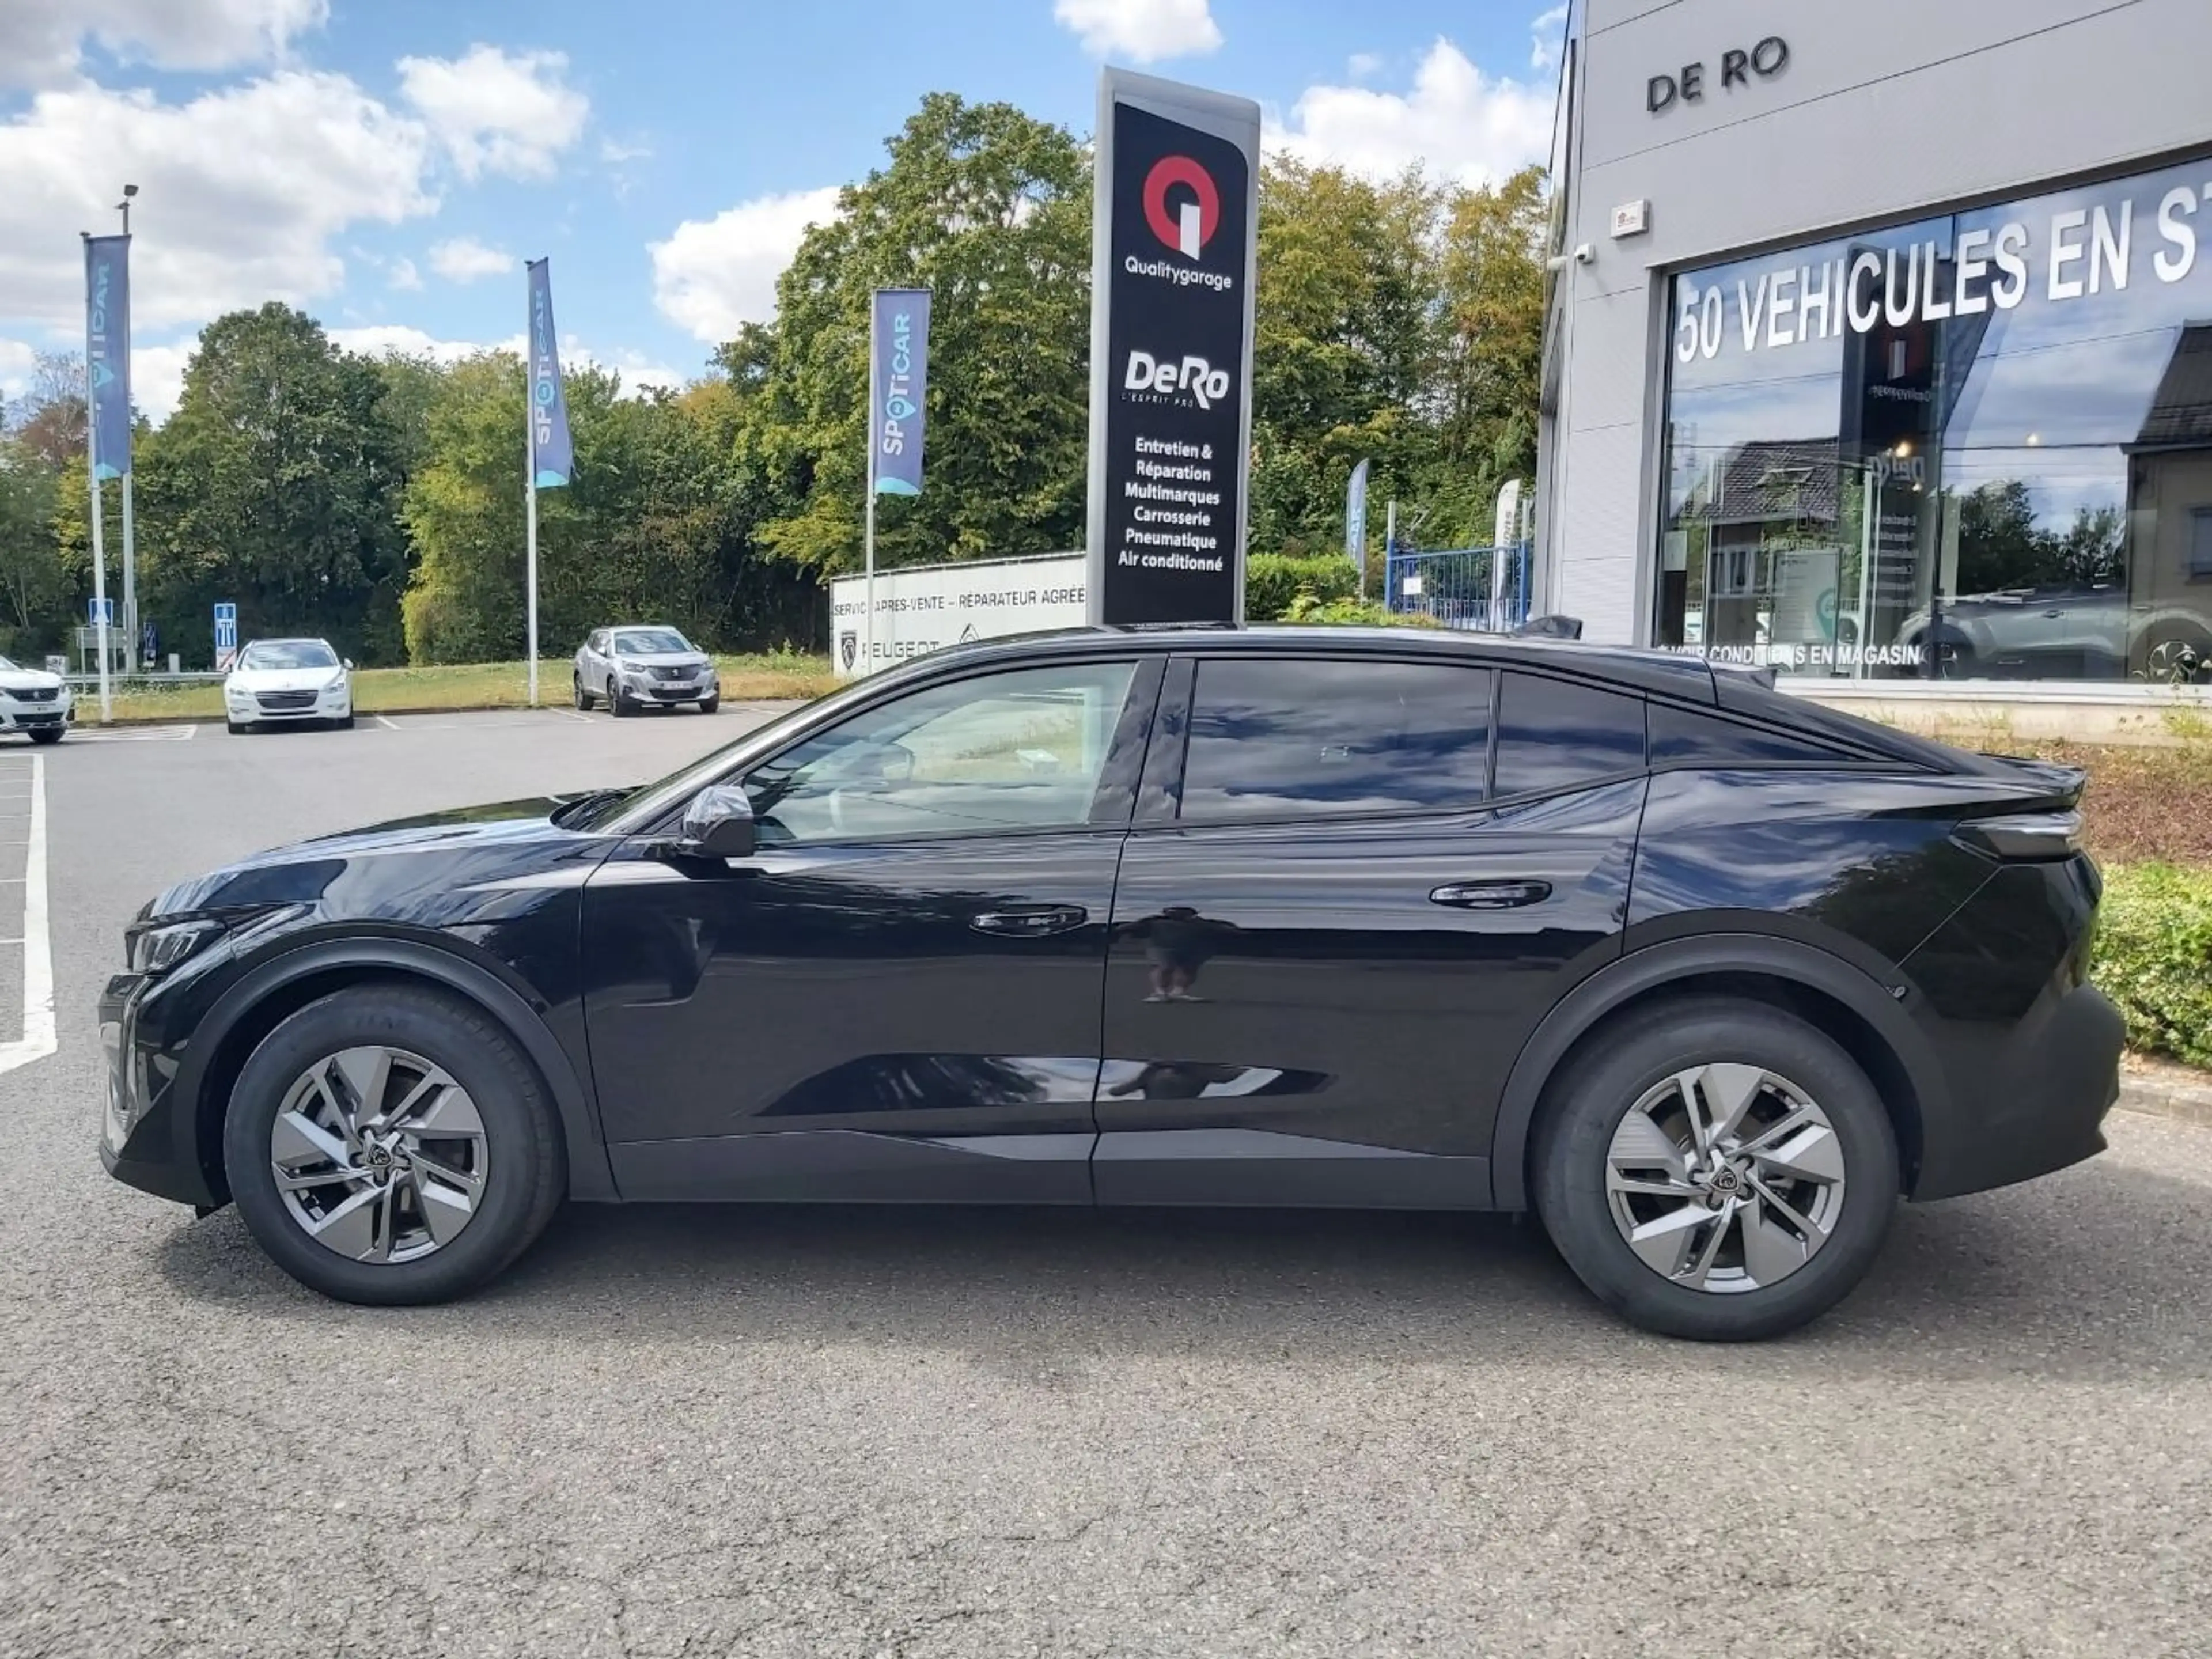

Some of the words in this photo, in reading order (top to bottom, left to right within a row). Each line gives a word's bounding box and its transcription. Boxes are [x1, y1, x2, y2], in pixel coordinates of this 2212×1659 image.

[1647, 62, 1703, 112] DE
[1721, 36, 1790, 88] RO
[1125, 256, 1232, 290] Qualitygarage
[1676, 285, 1722, 363] 50
[1738, 222, 2027, 351] VEHICULES
[2048, 199, 2133, 301] EN
[2153, 181, 2212, 282] S
[1124, 350, 1229, 410] DeRo
[1135, 436, 1199, 459] Entretien
[1201, 444, 1213, 459] &
[1136, 459, 1211, 482] Réparation
[1125, 482, 1221, 507] Multimarques
[1134, 505, 1210, 527] Carrosserie
[1126, 527, 1217, 552] Pneumatique
[1118, 550, 1139, 566] Air
[1141, 552, 1223, 571] conditionné
[834, 601, 868, 616] SERVIC
[1810, 645, 1833, 665] EN
[1838, 644, 1920, 665] MAGASIN
